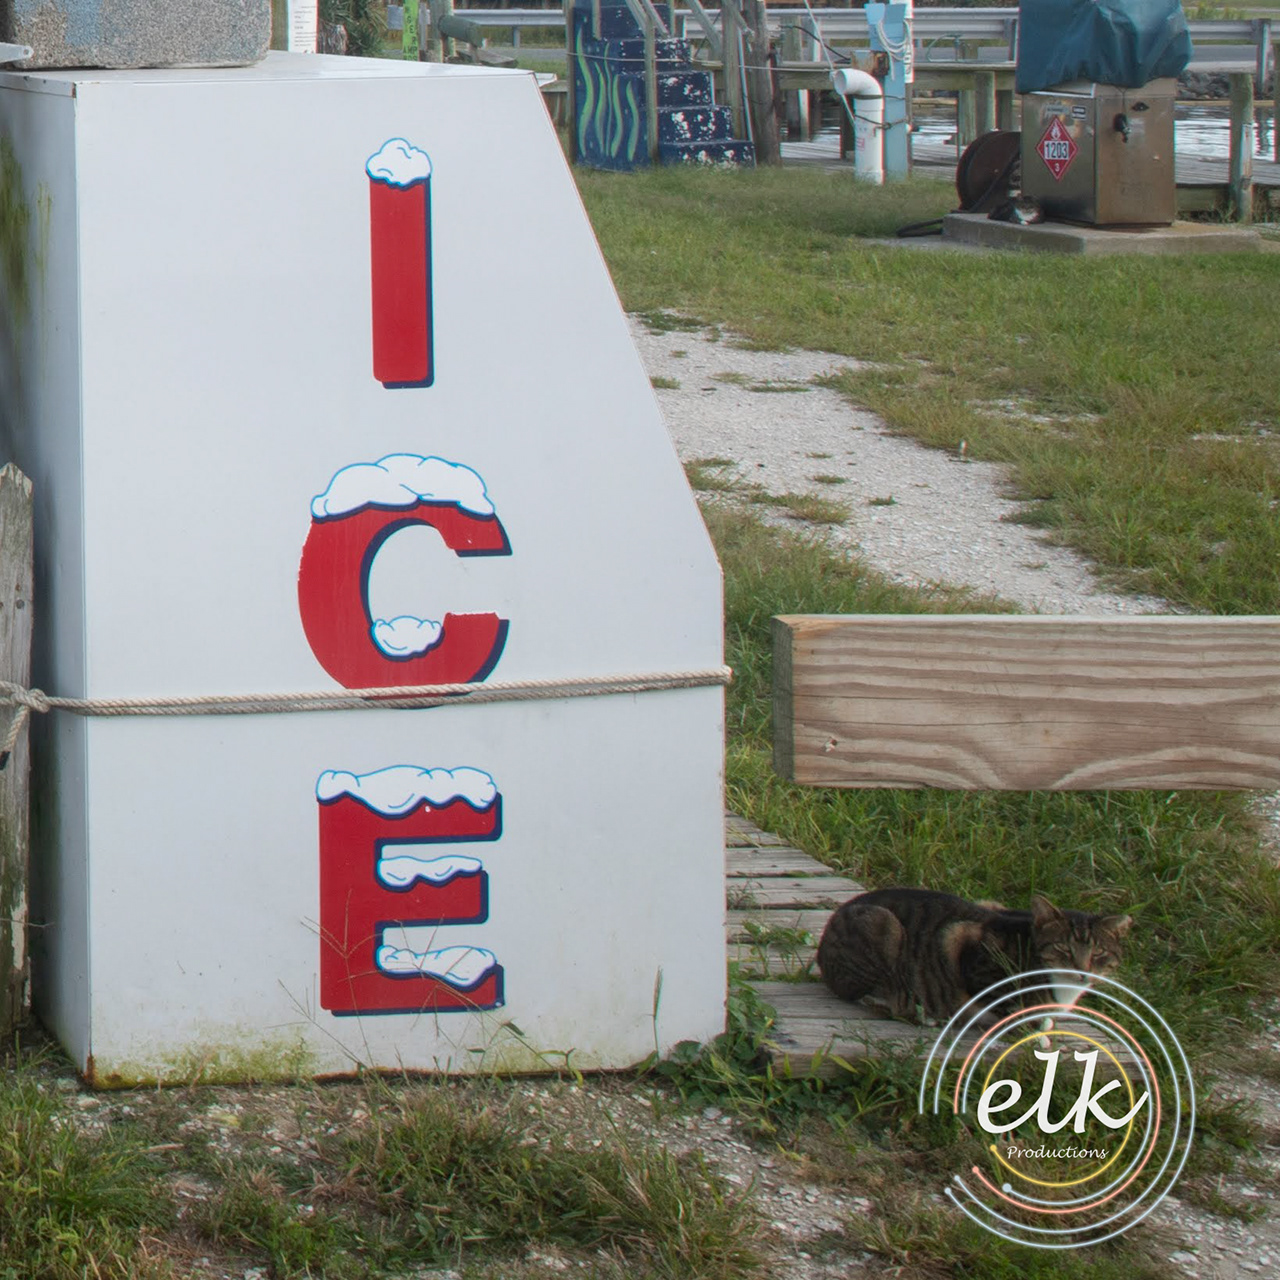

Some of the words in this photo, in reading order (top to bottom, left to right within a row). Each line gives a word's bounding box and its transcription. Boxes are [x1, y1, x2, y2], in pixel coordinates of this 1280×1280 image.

[1045, 142, 1068, 158] 1203
[1054, 163, 1060, 172] 3
[297, 138, 513, 1017] ICE
